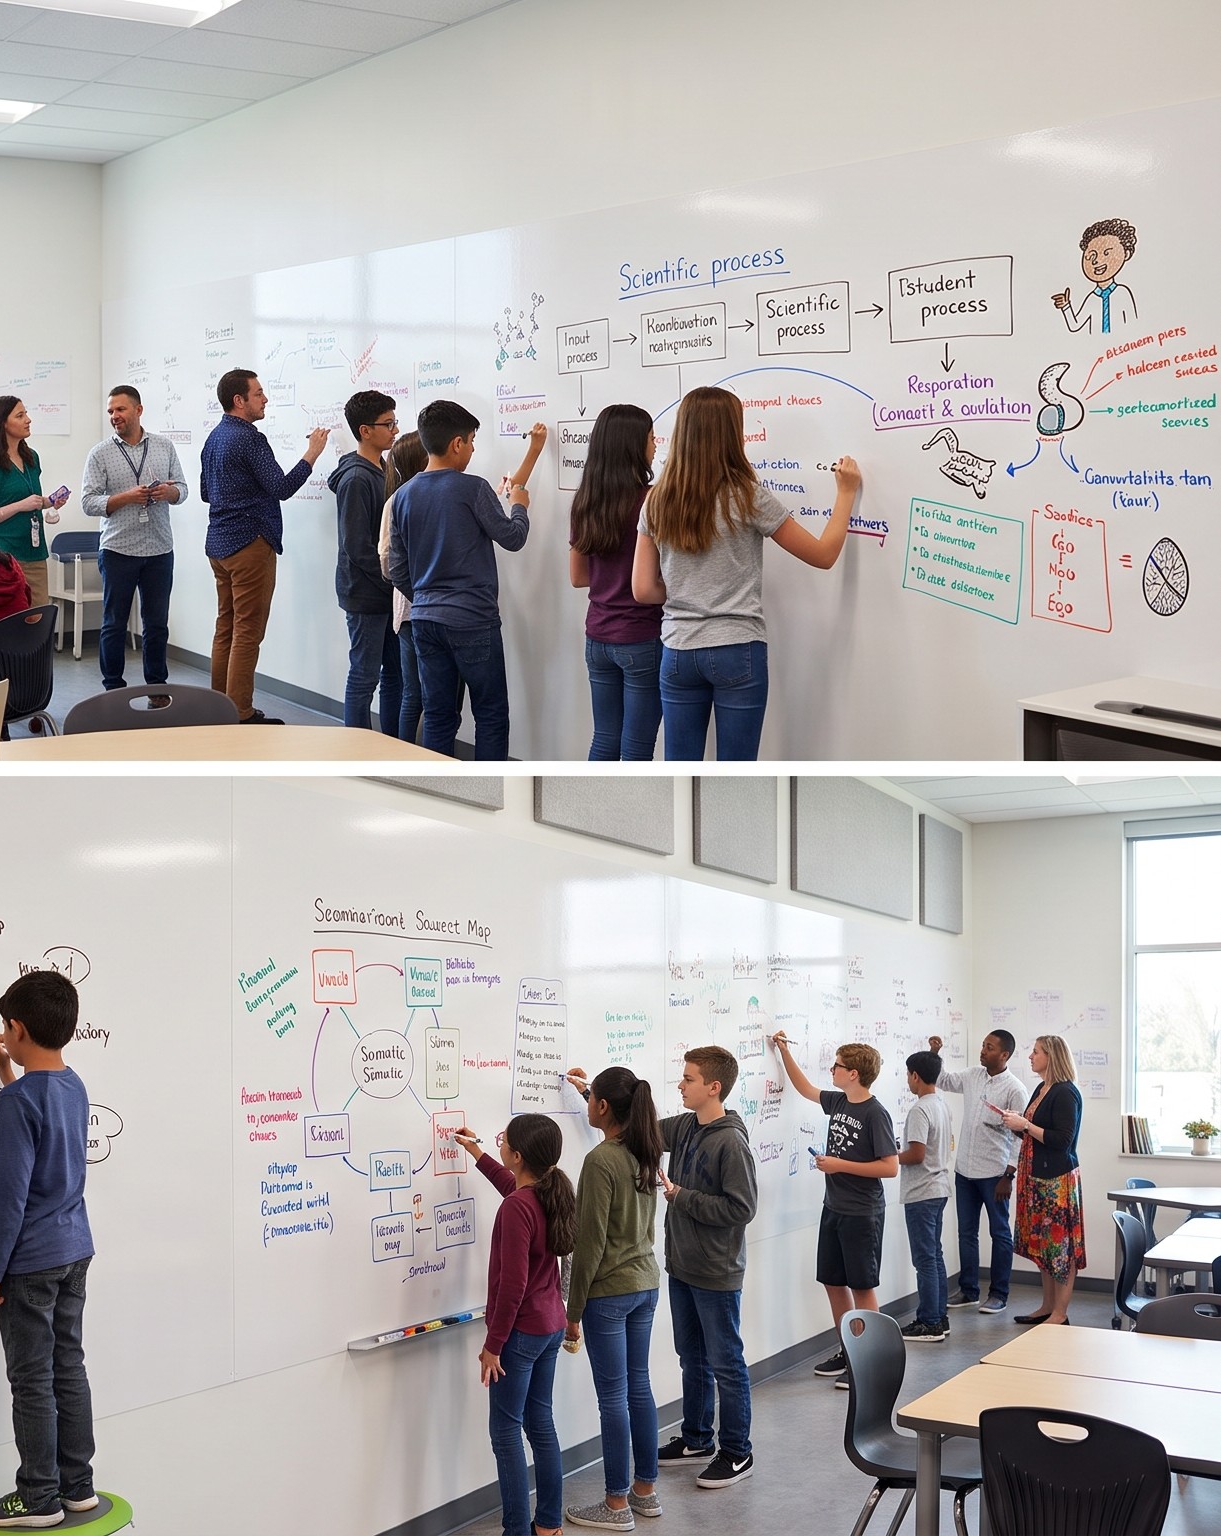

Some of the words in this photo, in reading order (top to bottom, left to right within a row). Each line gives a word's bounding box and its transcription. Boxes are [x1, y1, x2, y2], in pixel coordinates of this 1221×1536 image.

[619, 257, 700, 292] Scientific
[711, 248, 785, 288] process
[765, 292, 841, 319] Scientific
[921, 298, 988, 327] process
[564, 329, 591, 346] Input
[776, 321, 826, 346] process
[907, 373, 994, 398] Resporation
[941, 398, 955, 417] &
[467, 919, 492, 943] Map
[360, 1045, 407, 1063] Somatic
